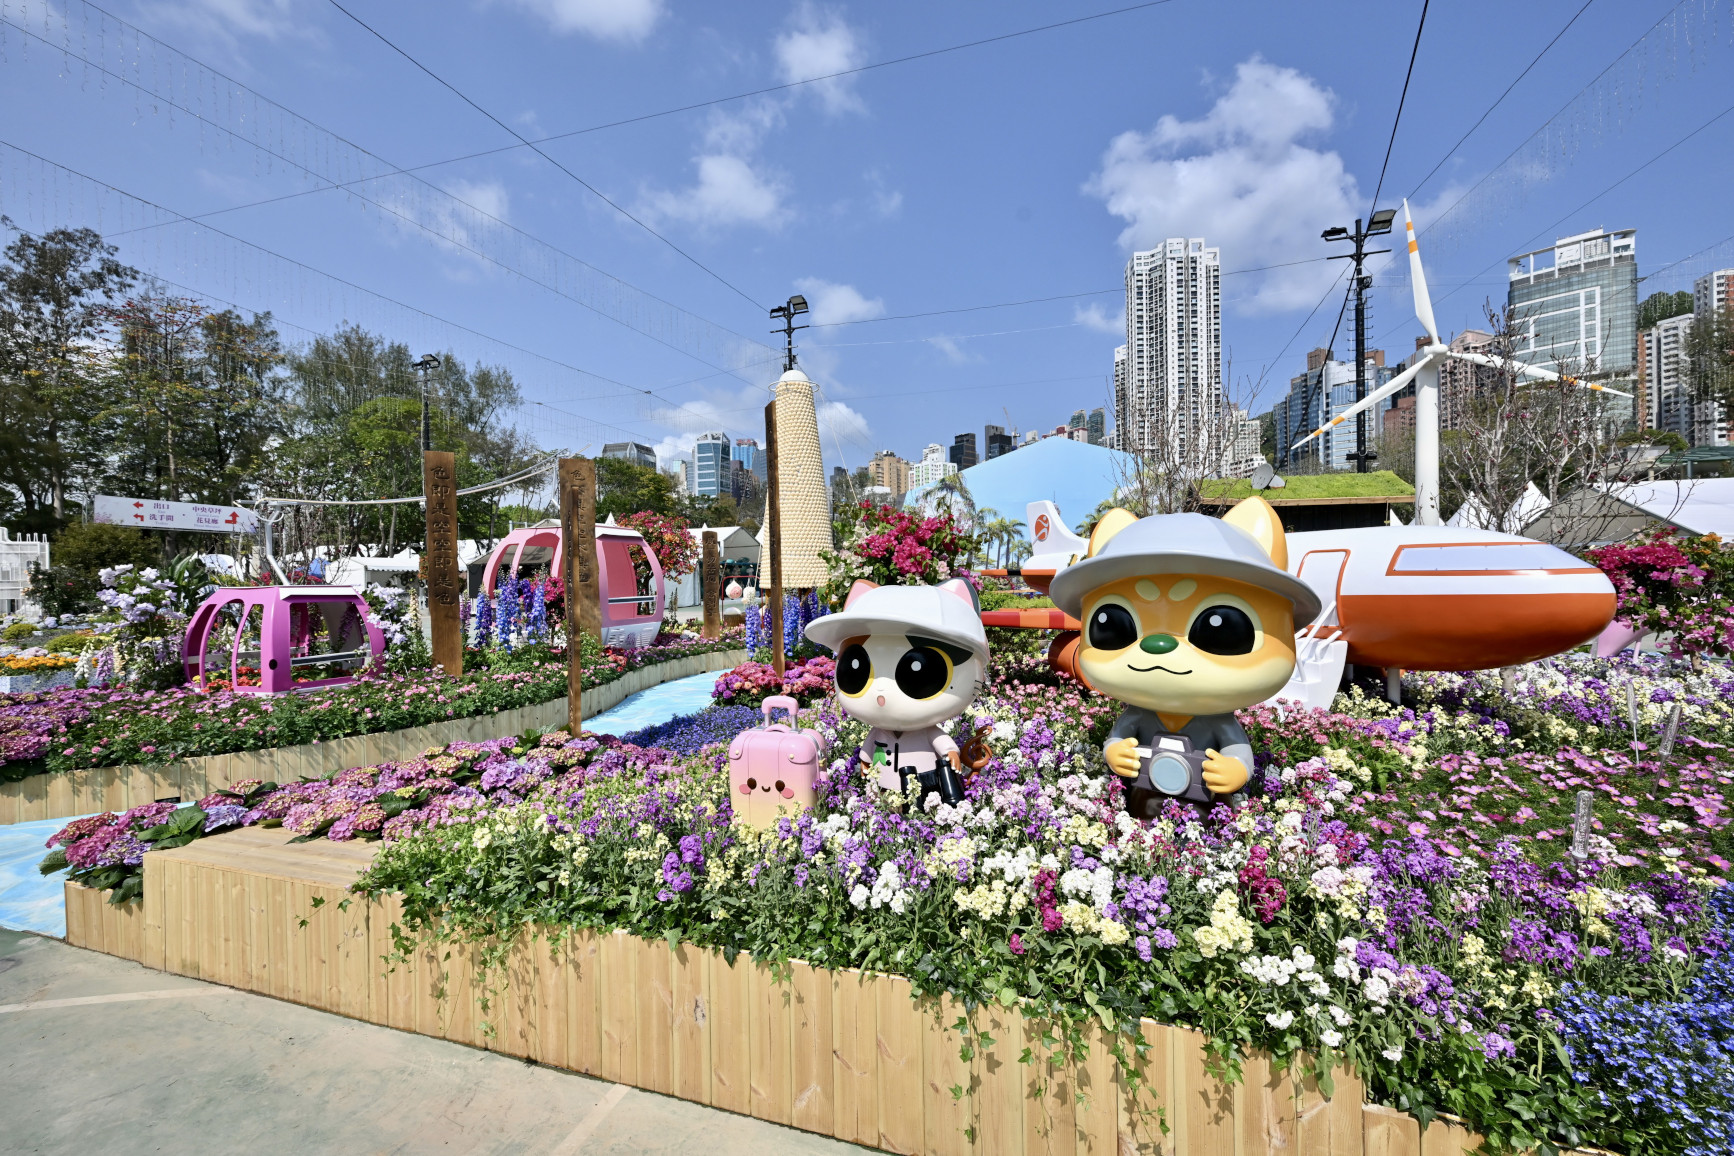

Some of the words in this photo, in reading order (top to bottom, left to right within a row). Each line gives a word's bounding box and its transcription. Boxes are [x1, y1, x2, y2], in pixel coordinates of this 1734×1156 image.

[192, 506, 222, 514] 中央草坪
[149, 513, 174, 521] 洗手間
[430, 466, 455, 606] 色即是空空即是色
